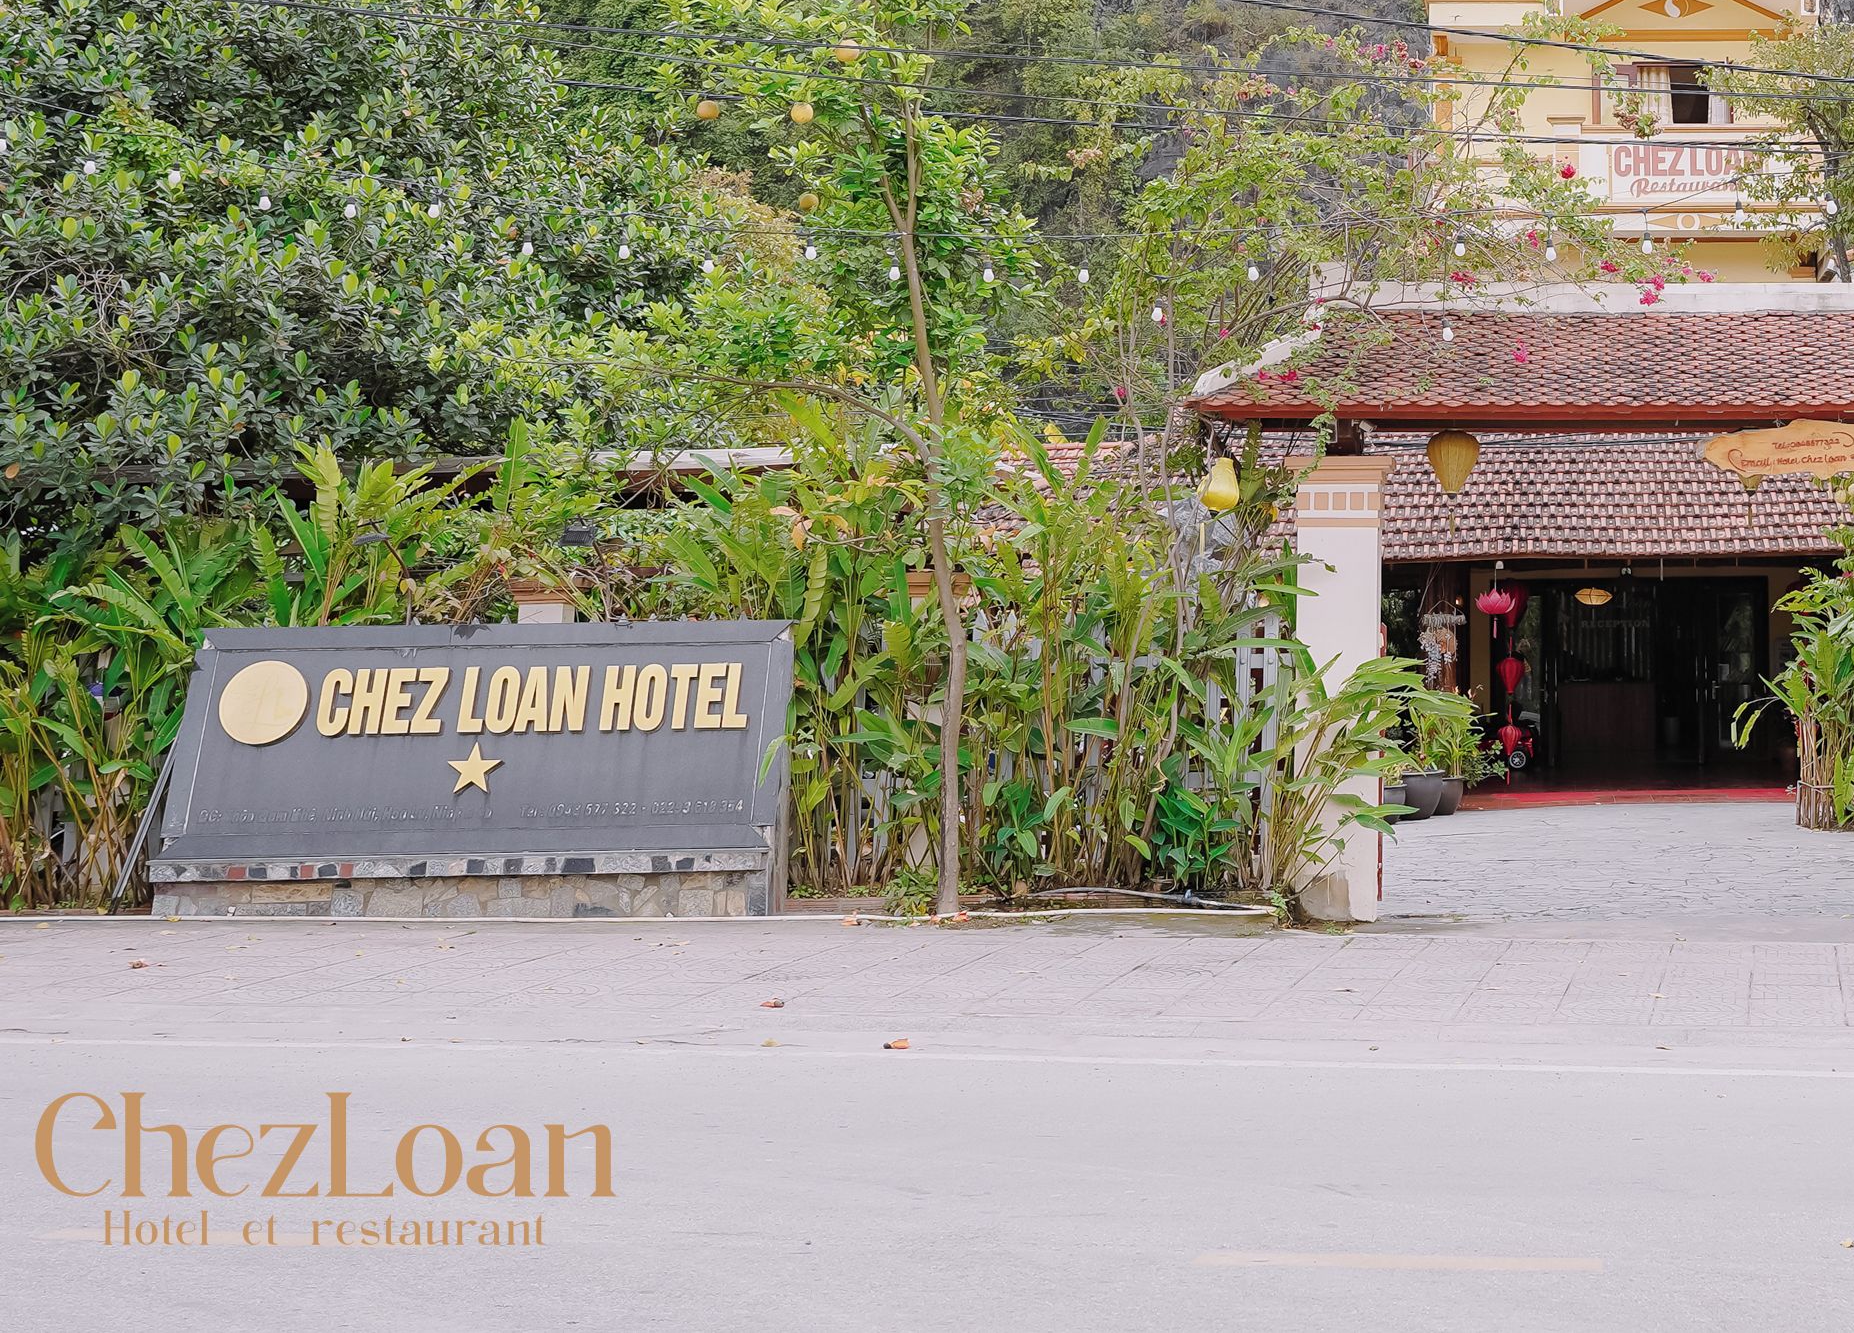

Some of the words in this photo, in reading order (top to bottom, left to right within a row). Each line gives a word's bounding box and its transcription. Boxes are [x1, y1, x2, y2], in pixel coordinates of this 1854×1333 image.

[1614, 146, 1684, 177] CHEZ
[1630, 177, 1742, 198] Restauran
[315, 666, 450, 737] CHEZ
[456, 664, 591, 735] LOAN
[598, 661, 749, 732] HOTEL
